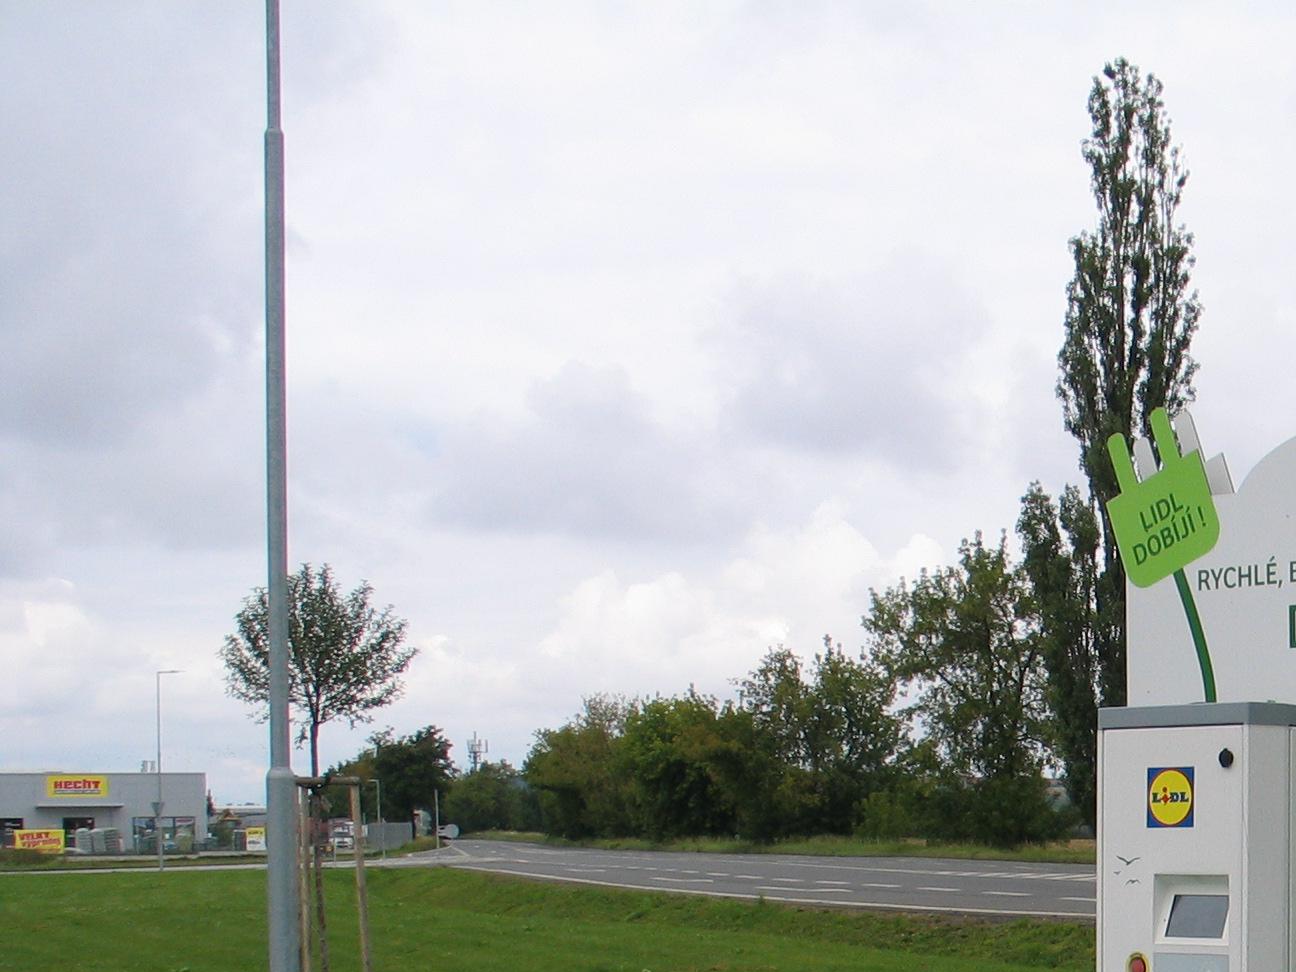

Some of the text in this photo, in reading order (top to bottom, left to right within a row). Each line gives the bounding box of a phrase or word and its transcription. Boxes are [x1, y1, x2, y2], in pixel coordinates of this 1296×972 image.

[1139, 493, 1183, 532] LIDL
[1198, 556, 1283, 591] RYCHLÉ,
[1152, 786, 1190, 805] LIDL
